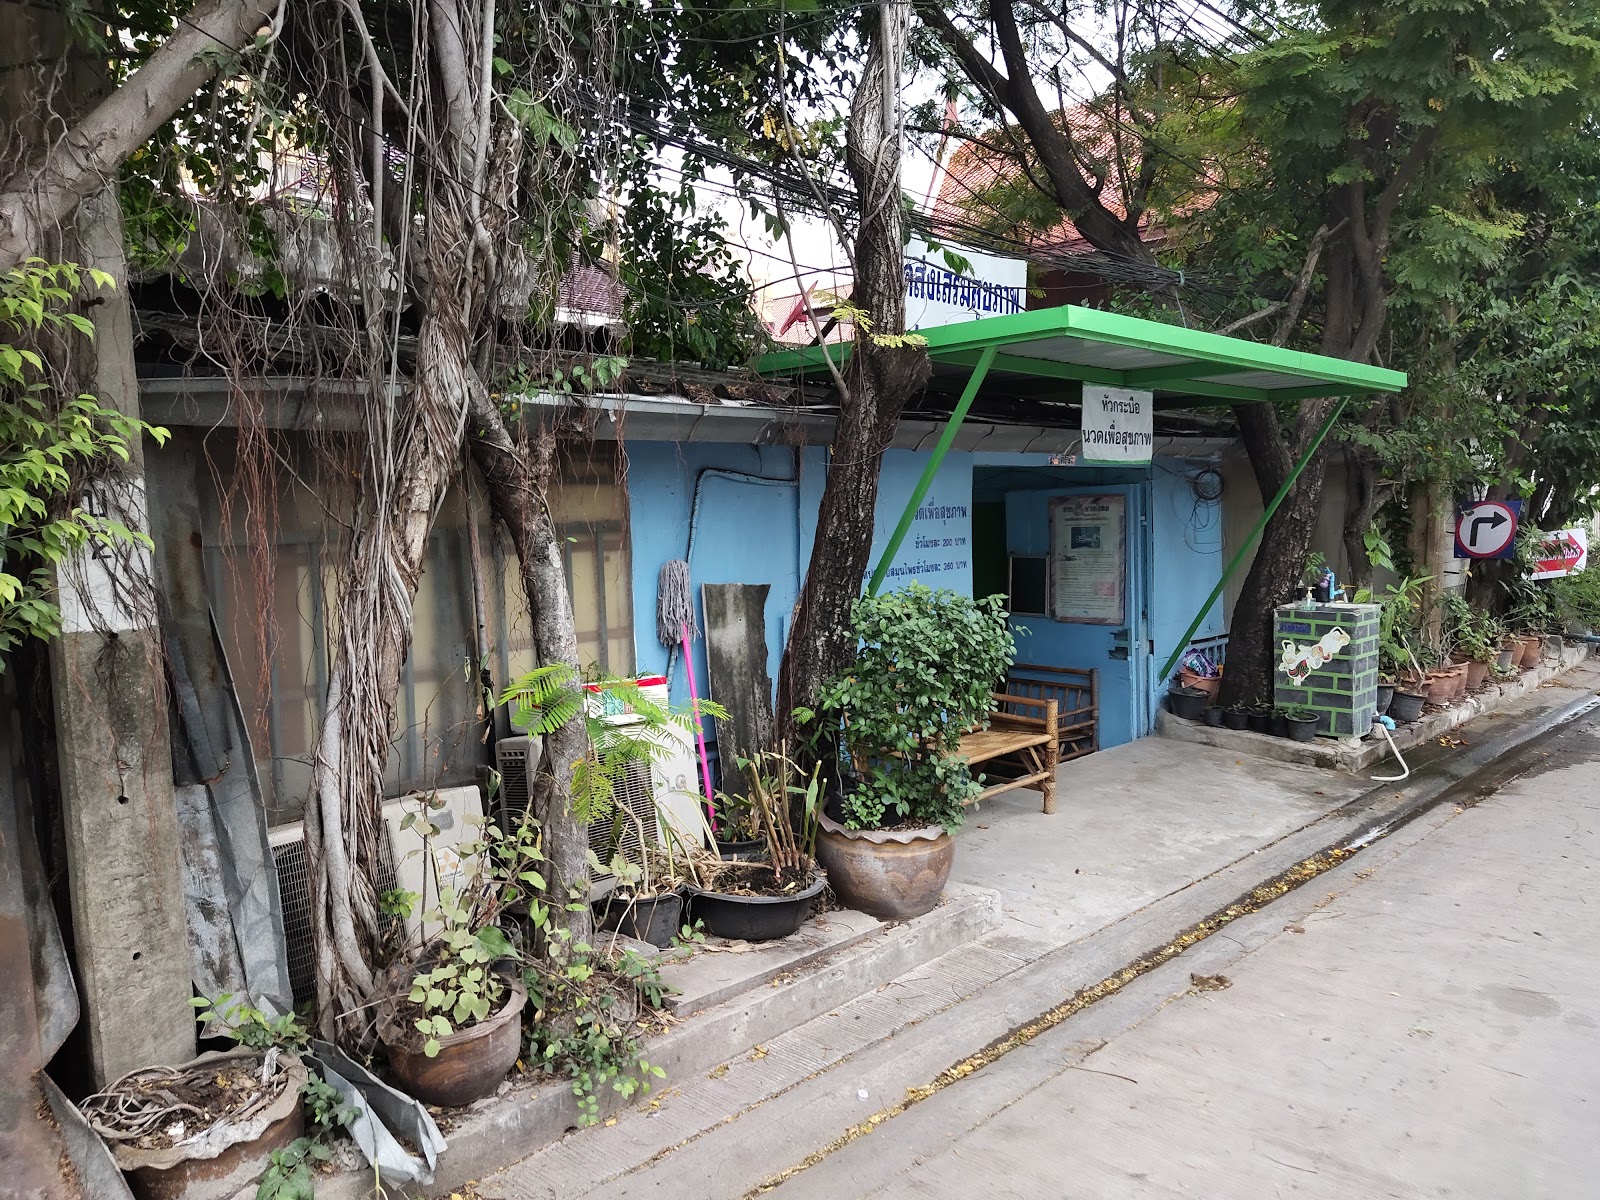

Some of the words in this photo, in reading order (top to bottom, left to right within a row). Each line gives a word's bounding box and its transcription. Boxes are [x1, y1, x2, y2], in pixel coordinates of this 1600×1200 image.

[904, 255, 1020, 321] ดส่งเสรมสุขภาพ
[1082, 419, 1152, 453] นวดเพื่อสุขภาพ
[942, 538, 953, 548] 200
[954, 536, 967, 546] บาท
[943, 562, 954, 571] 360
[955, 560, 968, 569] บาท
[665, 774, 688, 792] LG
